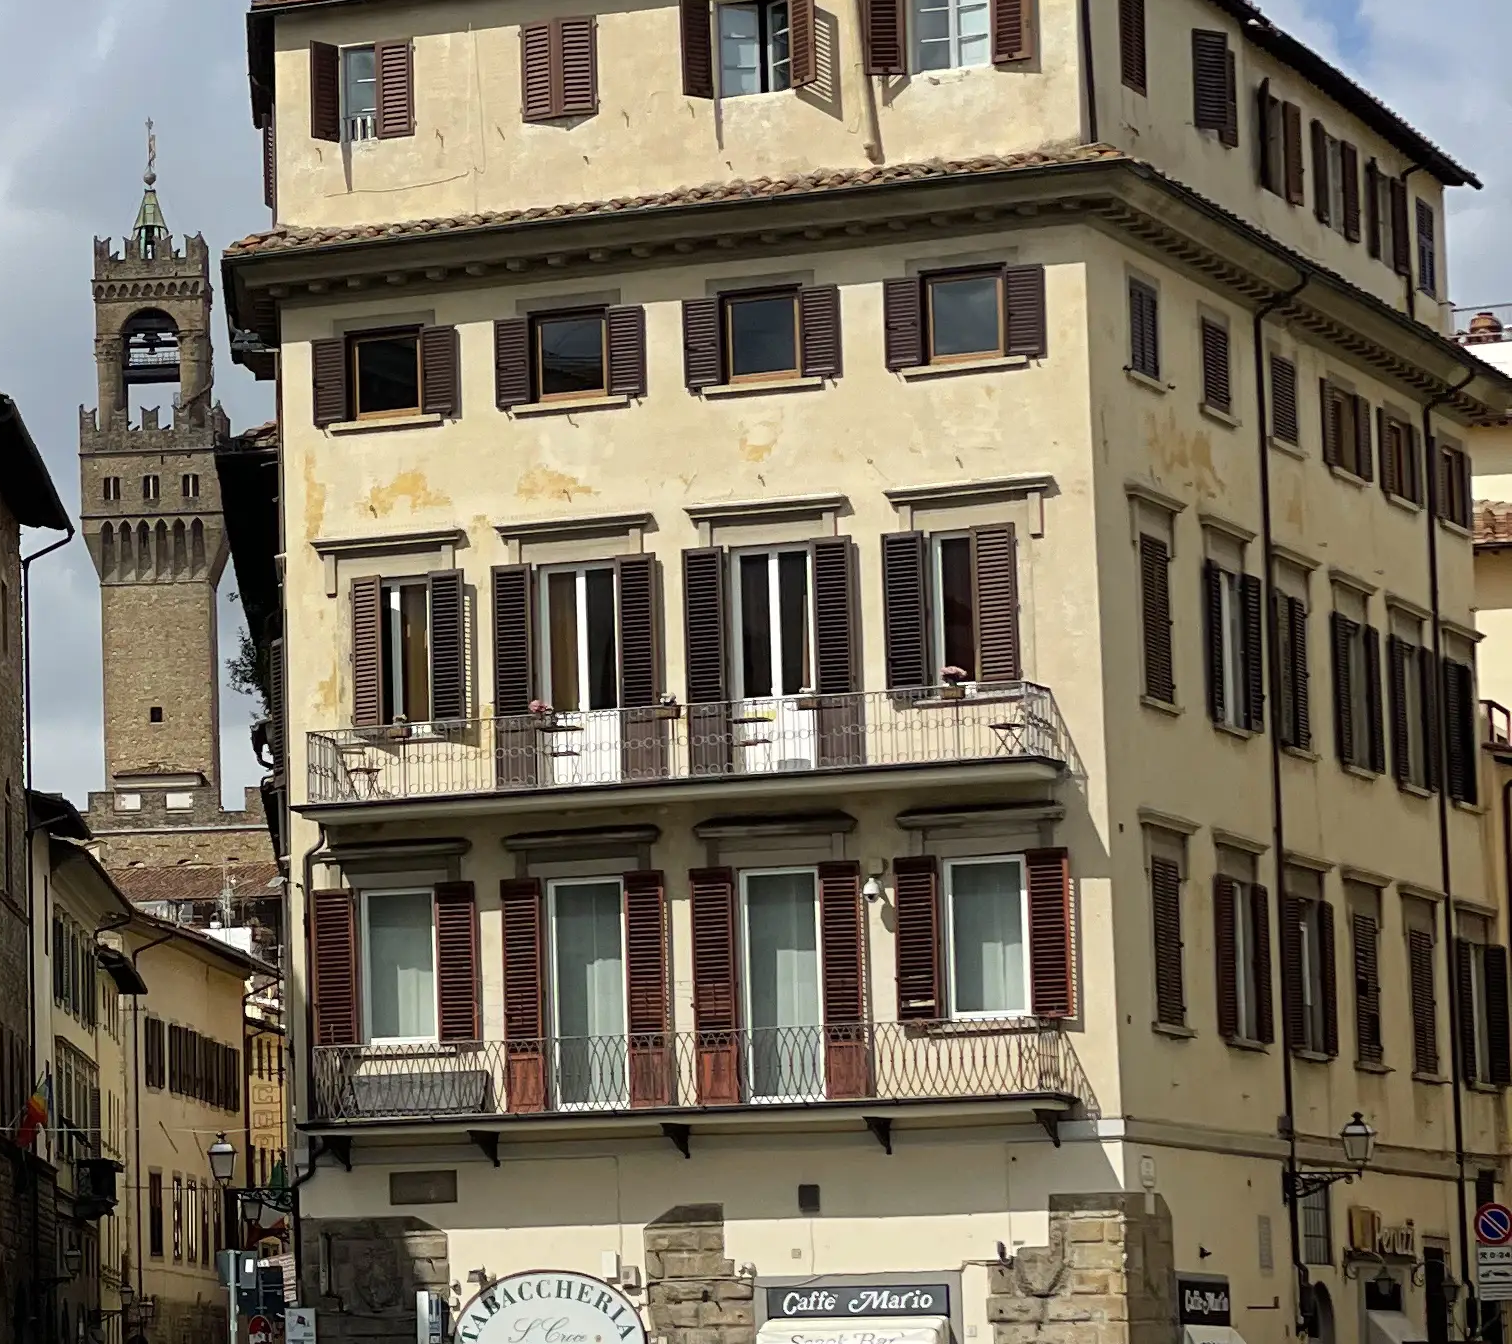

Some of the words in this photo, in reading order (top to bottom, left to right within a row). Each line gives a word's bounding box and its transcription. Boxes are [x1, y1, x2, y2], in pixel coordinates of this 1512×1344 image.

[461, 1279, 636, 1342] TABACCHERIA
[848, 1289, 933, 1313] Mario
[541, 1316, 588, 1343] Croce
